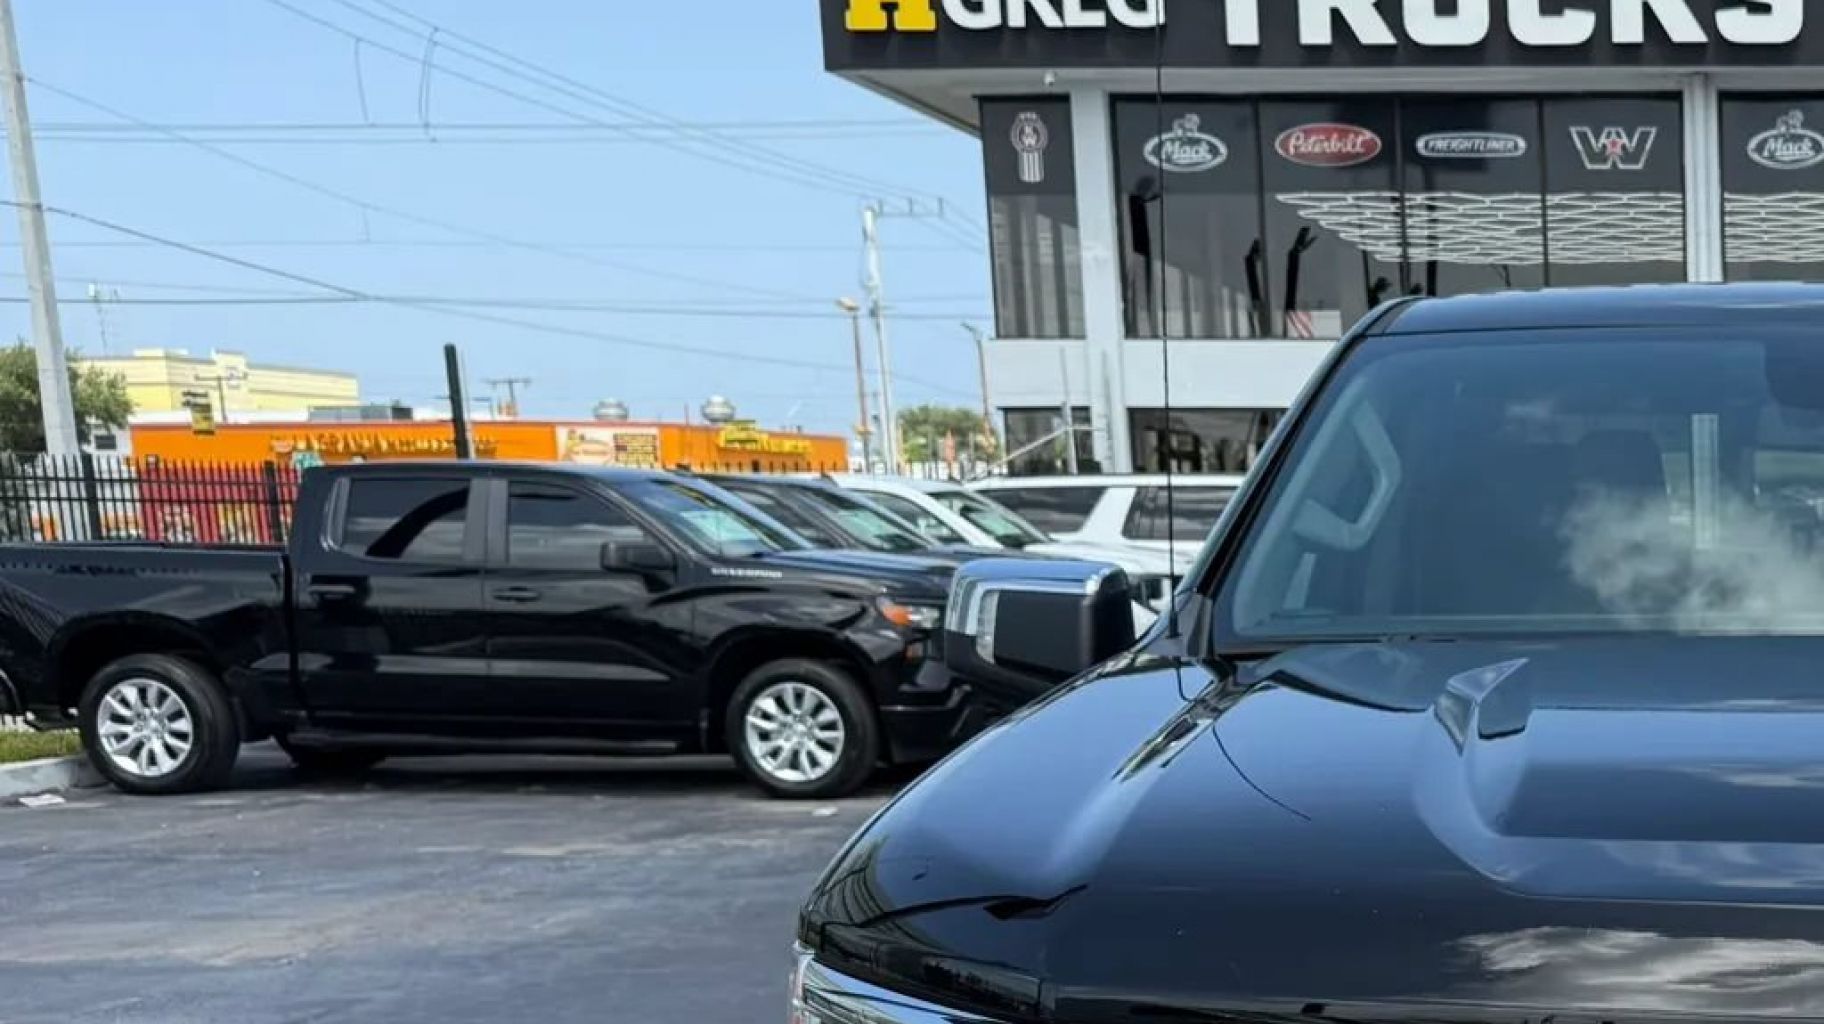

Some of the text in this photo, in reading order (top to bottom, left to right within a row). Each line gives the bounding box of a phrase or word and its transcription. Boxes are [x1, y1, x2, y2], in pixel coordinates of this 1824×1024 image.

[1288, 130, 1373, 156] Peterbilt
[1426, 138, 1517, 152] FREIGHTLINER
[1763, 136, 1816, 159] Mack
